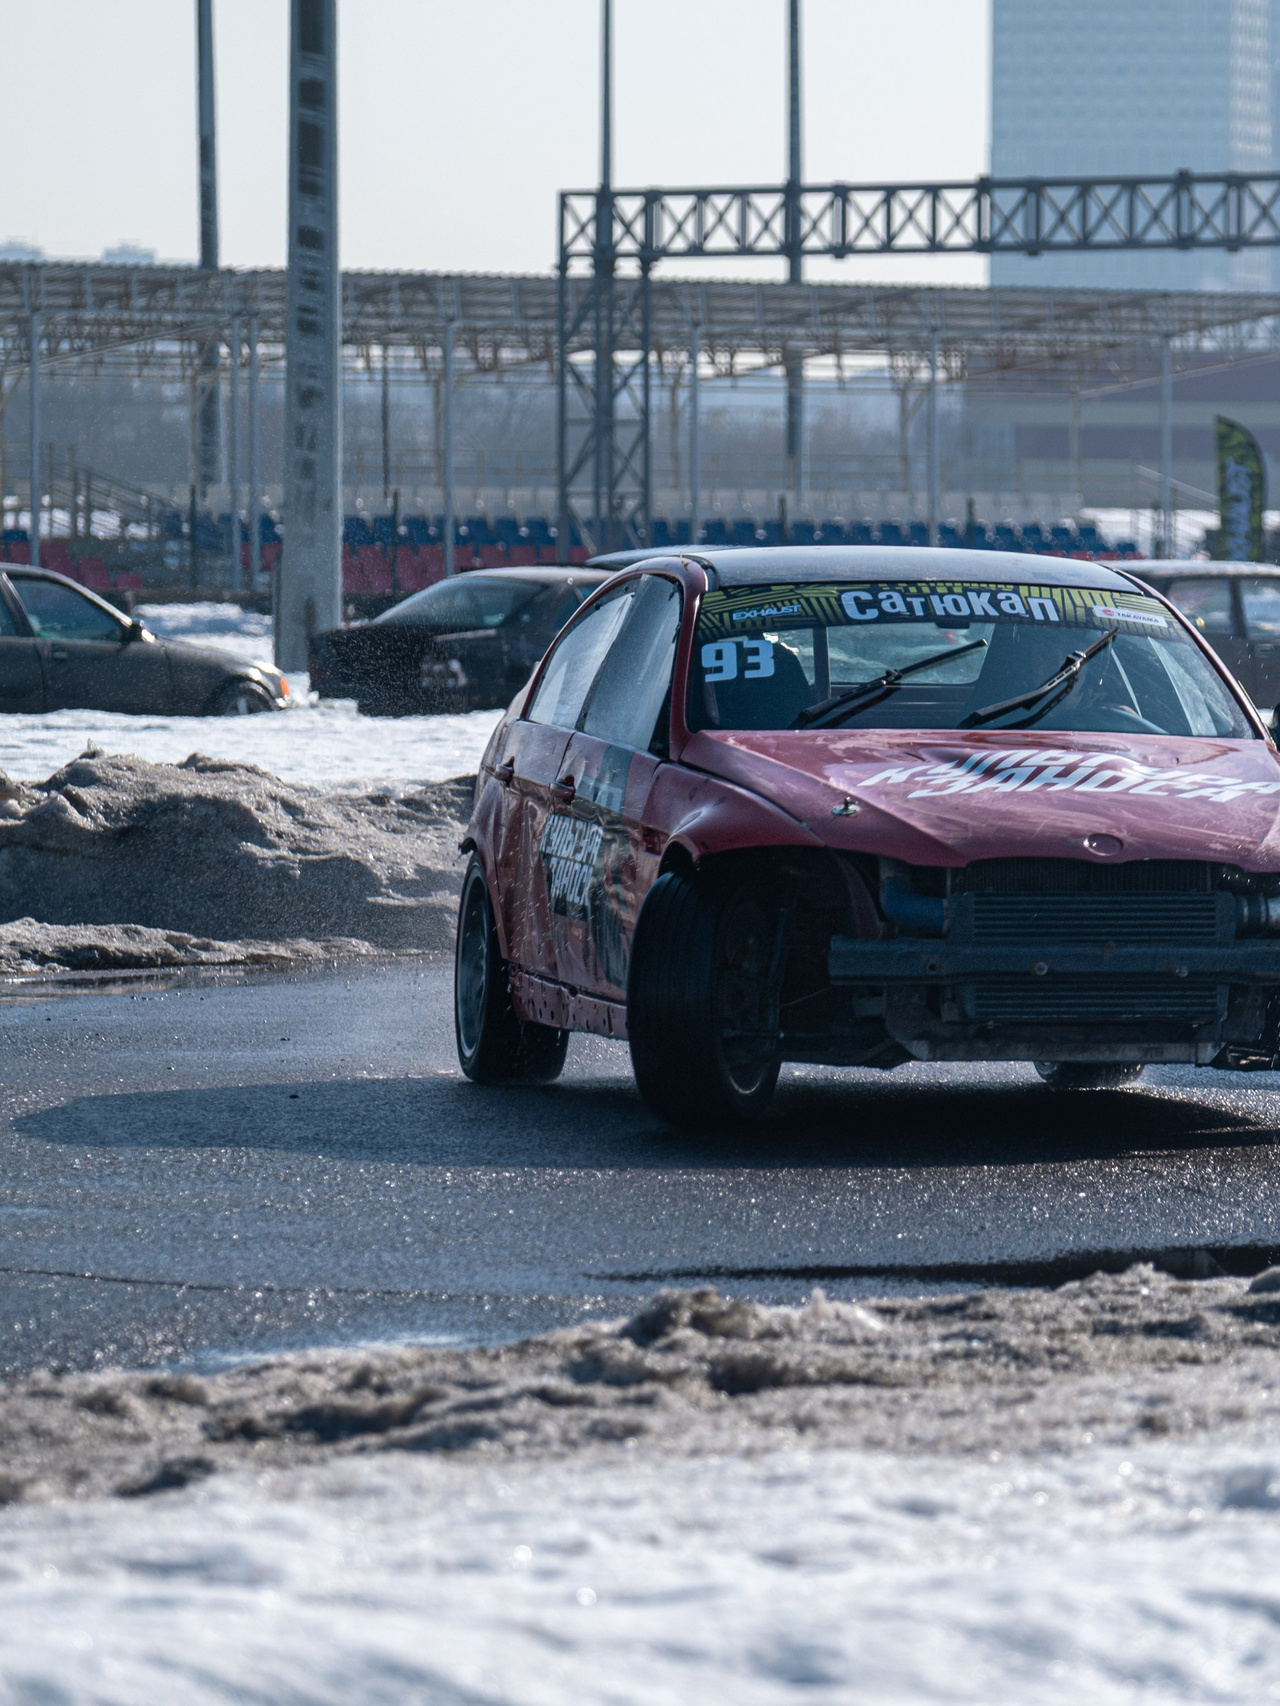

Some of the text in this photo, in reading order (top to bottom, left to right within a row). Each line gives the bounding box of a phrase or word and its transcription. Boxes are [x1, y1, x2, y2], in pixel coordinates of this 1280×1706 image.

[732, 604, 801, 621] EXHAUST
[840, 590, 1060, 622] Сатюкап
[701, 639, 775, 683] 93
